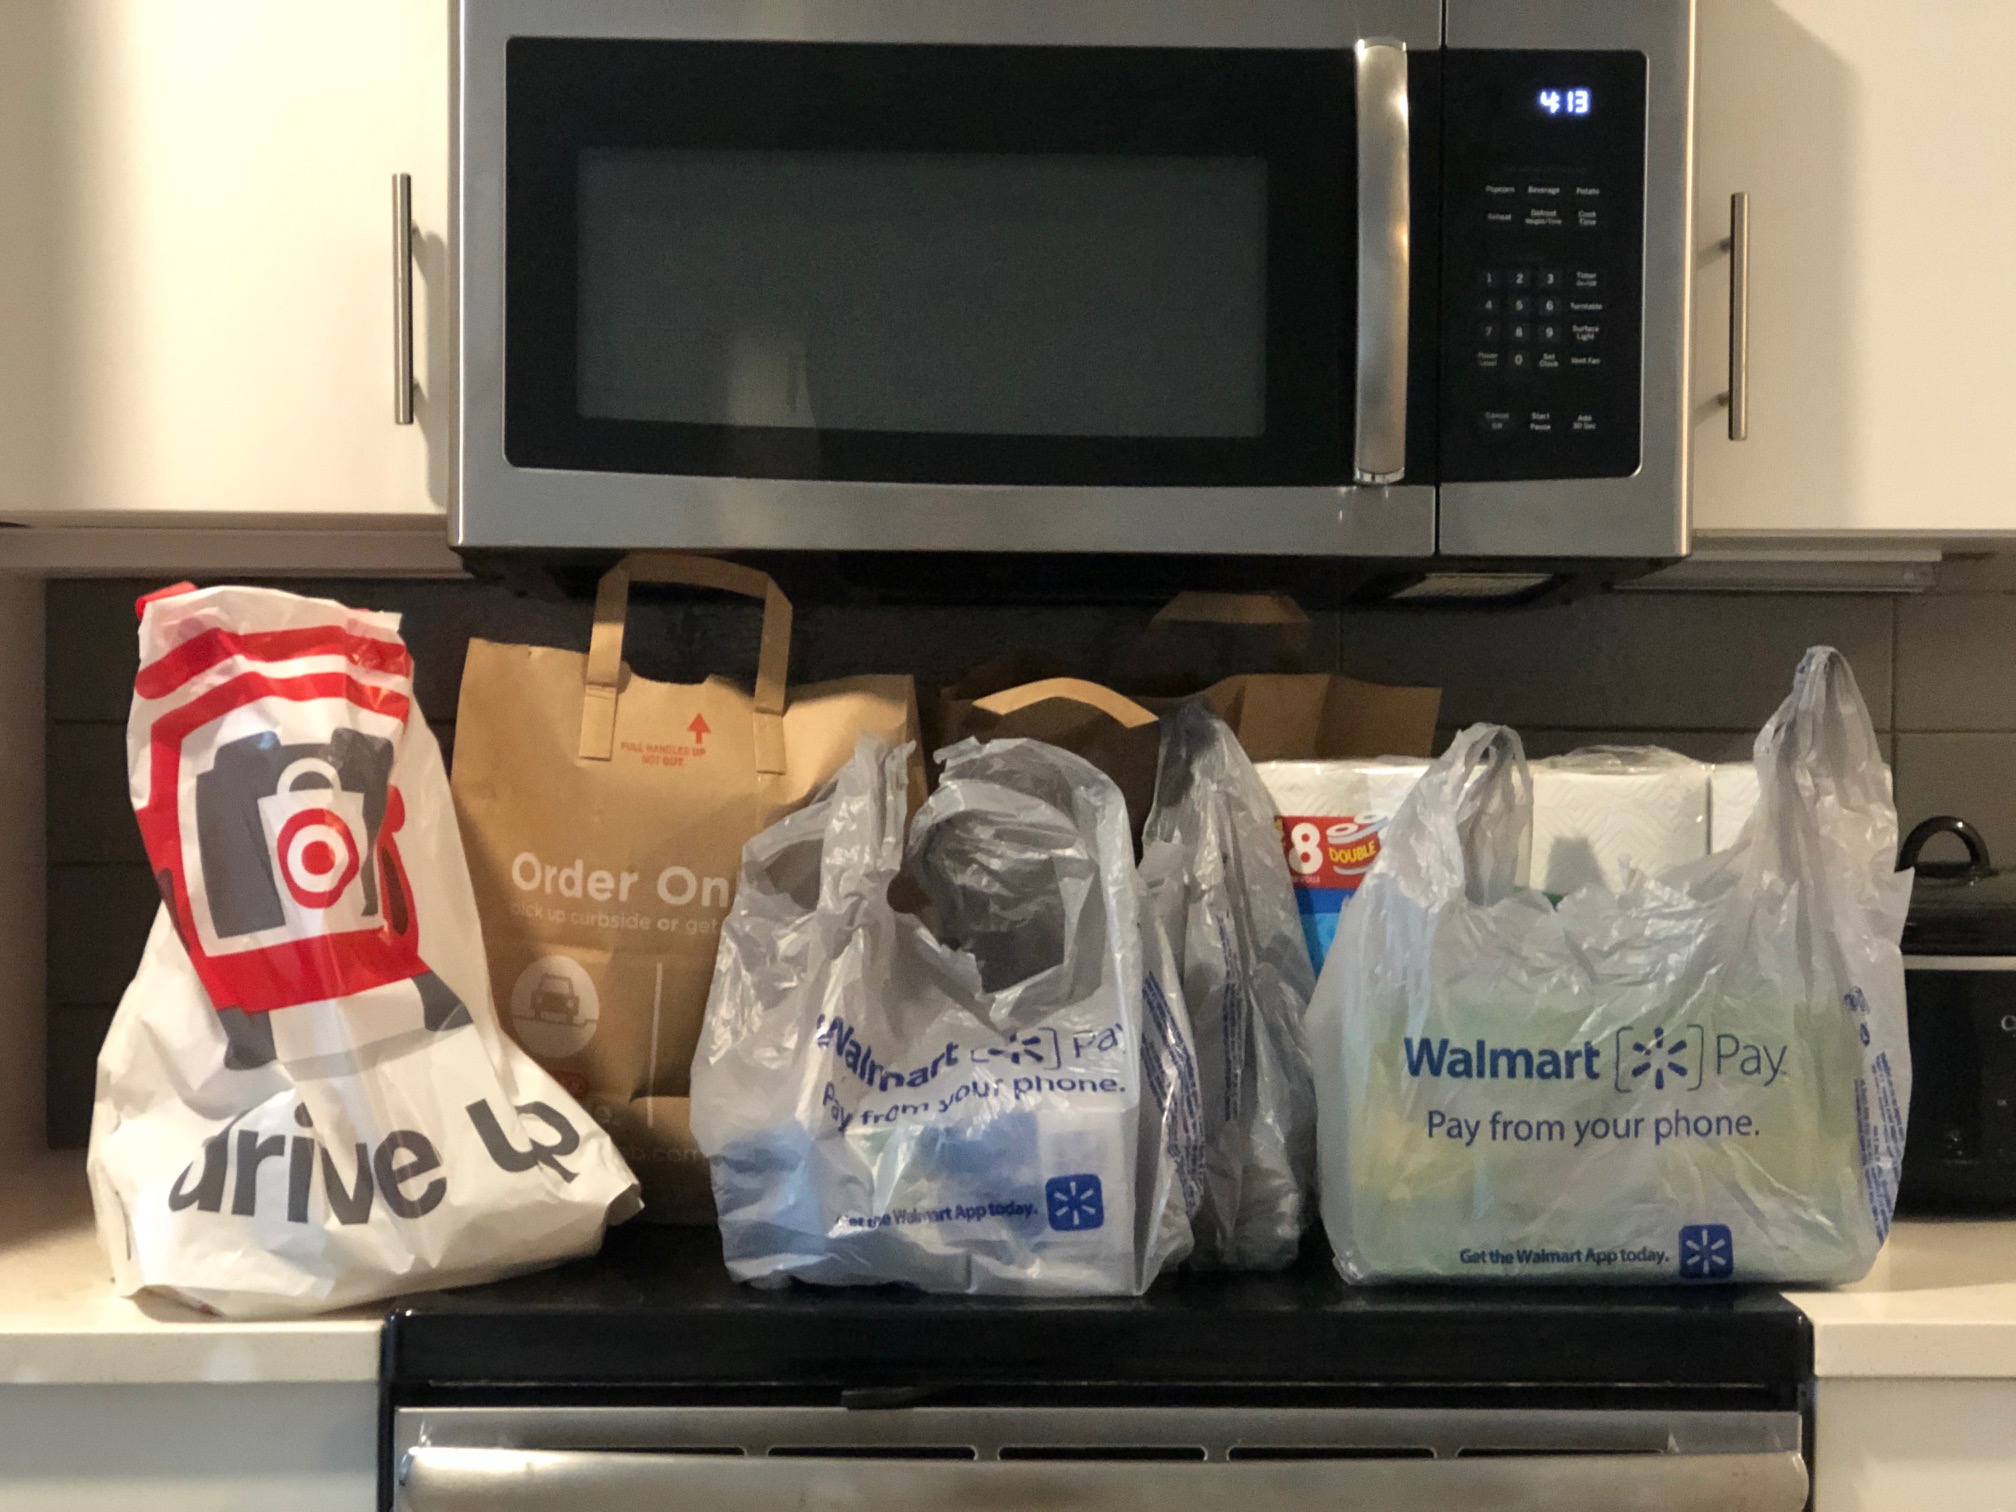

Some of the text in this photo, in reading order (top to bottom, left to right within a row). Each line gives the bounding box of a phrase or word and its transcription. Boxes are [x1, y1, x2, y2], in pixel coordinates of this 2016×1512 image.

[1487, 273, 1554, 284] 1 2 3
[1485, 300, 1554, 311] 4 5 6
[1486, 326, 1554, 338] 7 8 9
[1514, 355, 1523, 365] 0
[691, 747, 706, 757] UP
[1289, 823, 1323, 875] 8
[1328, 840, 1376, 863] DOUBLE
[511, 852, 639, 902] Order
[656, 917, 679, 931] or
[818, 1014, 959, 1092] Walmart
[1404, 1033, 1788, 1086] Walmart Pay
[823, 1081, 854, 1132] Pay
[861, 1102, 929, 1126] from
[1013, 1075, 1126, 1100] phone.
[1427, 1109, 1761, 1147] Pay from your phone.
[168, 1102, 448, 1226] drive
[893, 1208, 952, 1225] Walmart
[955, 1204, 987, 1223] App
[988, 1201, 1039, 1219] today.
[1460, 1247, 1670, 1266] Get the Walmart App today.
